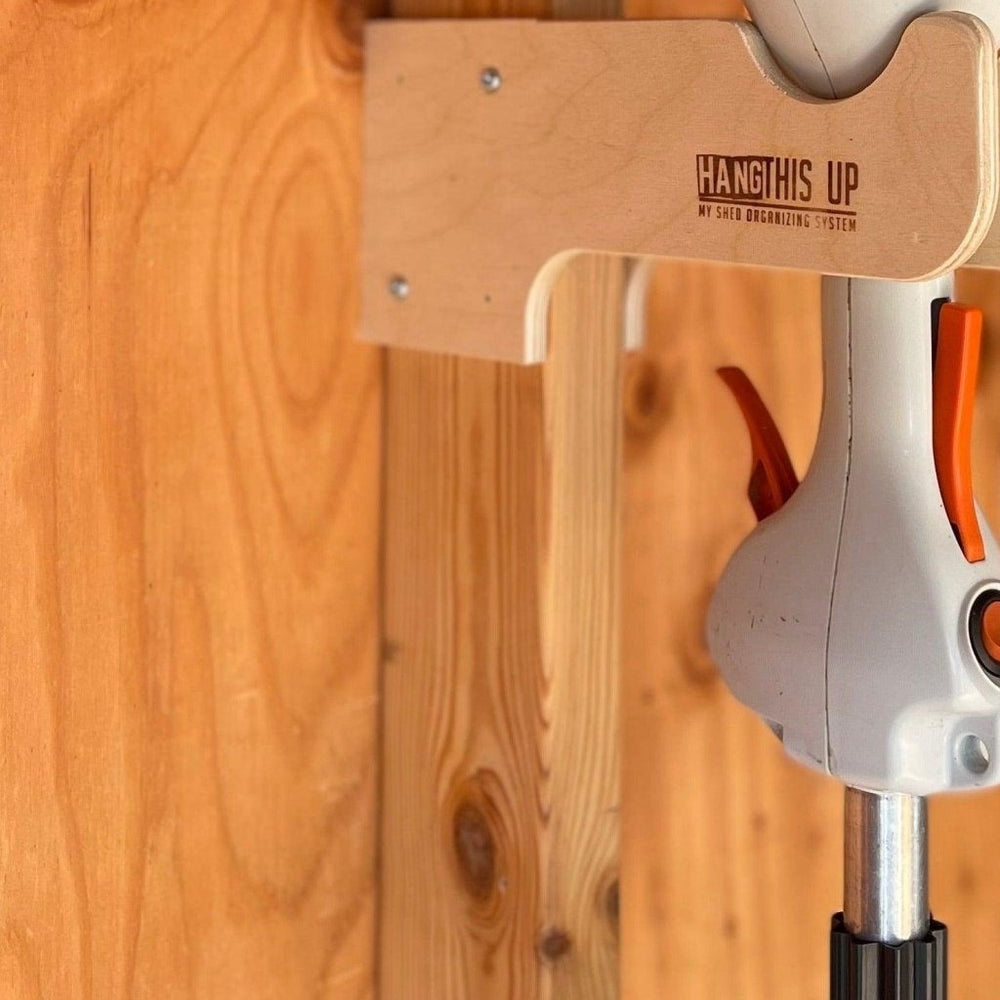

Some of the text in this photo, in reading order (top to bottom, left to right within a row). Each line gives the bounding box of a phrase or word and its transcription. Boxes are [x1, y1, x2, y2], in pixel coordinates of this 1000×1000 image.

[827, 160, 859, 206] UP
[698, 204, 857, 232] MY SHED ORGANIZING SYSTEM
